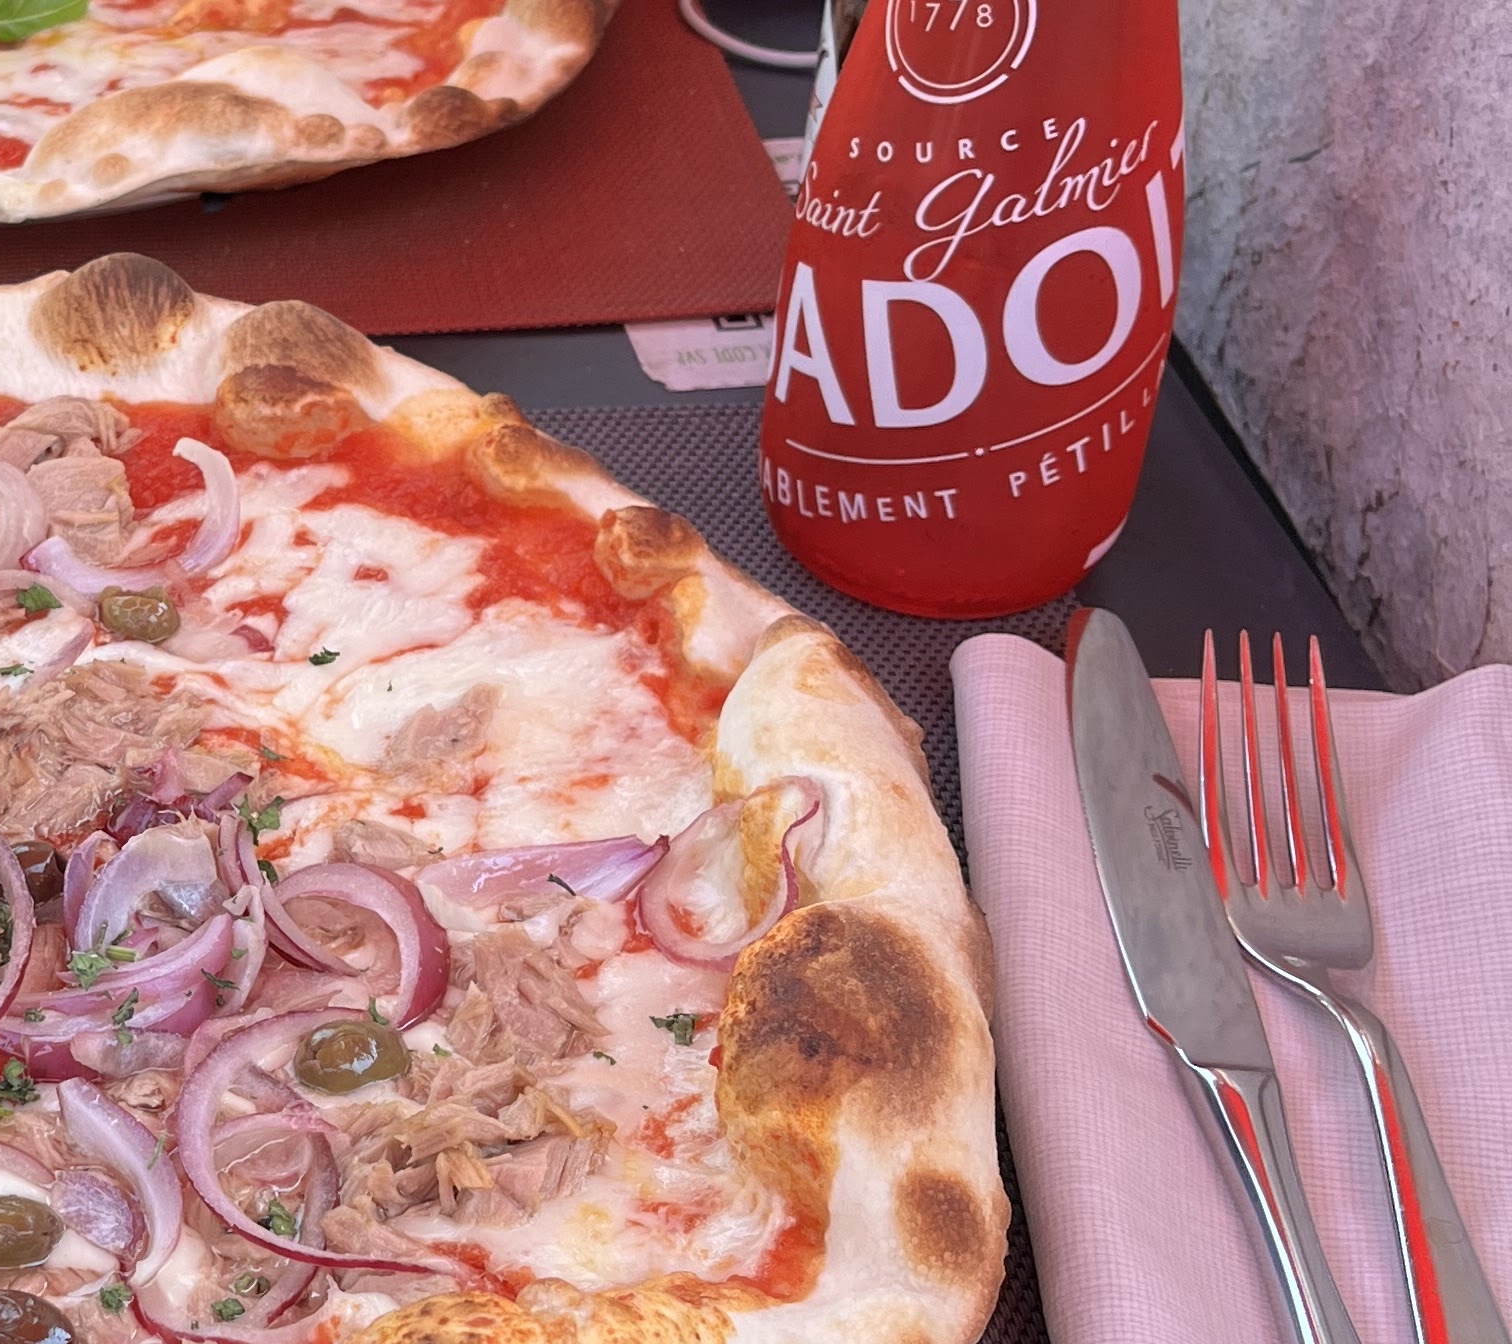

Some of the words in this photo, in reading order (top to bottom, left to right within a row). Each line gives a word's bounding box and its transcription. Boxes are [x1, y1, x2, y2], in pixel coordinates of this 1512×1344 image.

[795, 161, 883, 239] Saint
[902, 116, 1159, 284] Galmier
[848, 117, 1060, 163] SOURCE
[767, 116, 1186, 430] ADOI
[1008, 358, 1167, 498] PÉTILL
